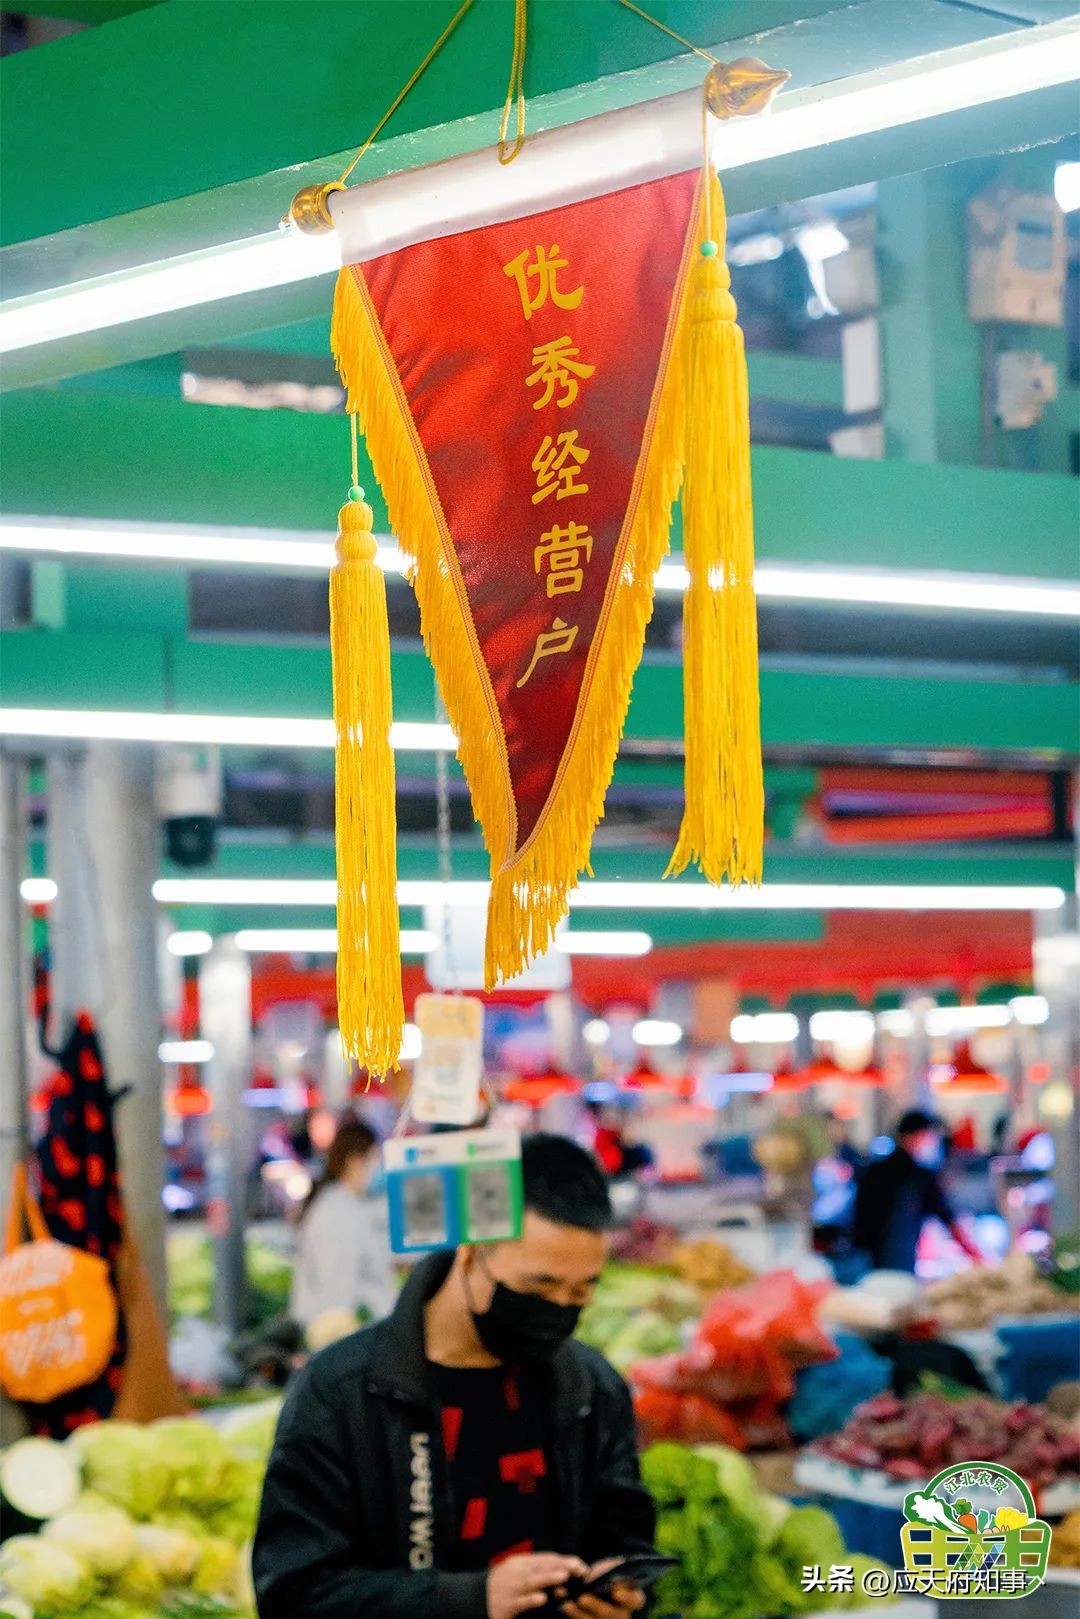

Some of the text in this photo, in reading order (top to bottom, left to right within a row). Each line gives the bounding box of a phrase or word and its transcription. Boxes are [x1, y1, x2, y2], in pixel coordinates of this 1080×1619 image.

[502, 244, 596, 689] 优秀经营户
